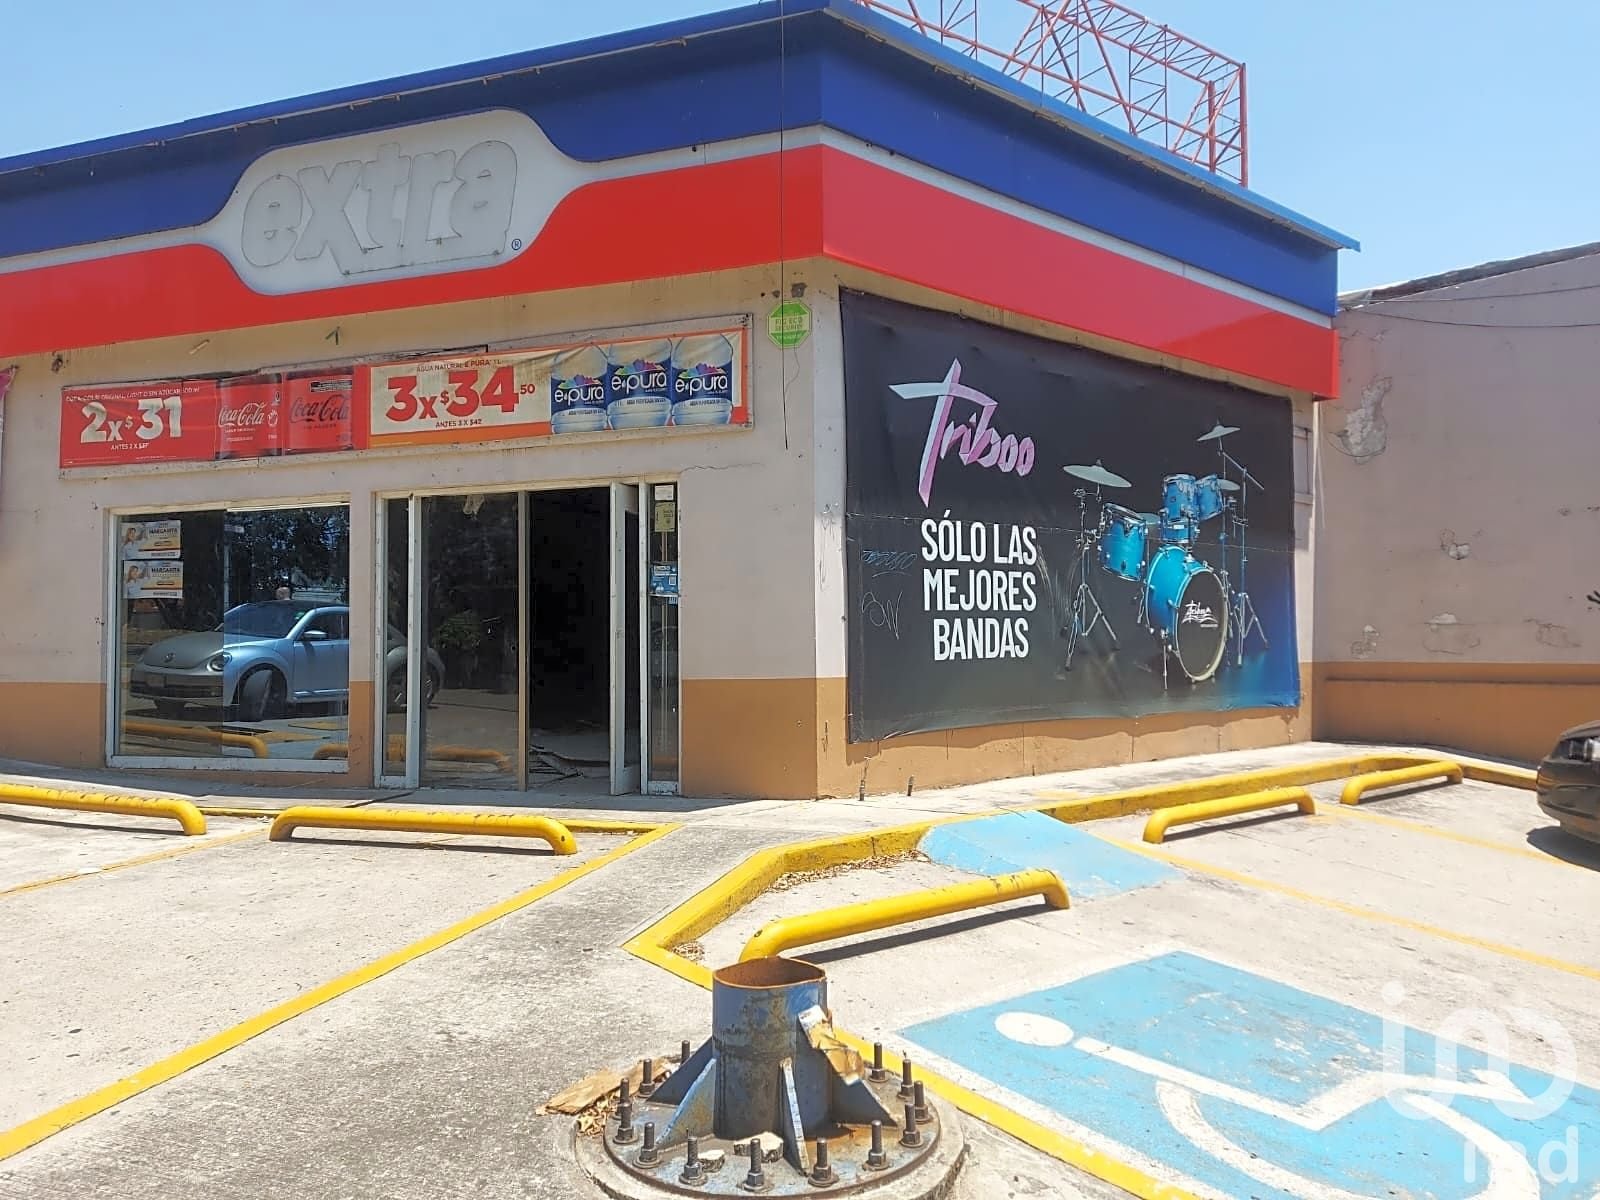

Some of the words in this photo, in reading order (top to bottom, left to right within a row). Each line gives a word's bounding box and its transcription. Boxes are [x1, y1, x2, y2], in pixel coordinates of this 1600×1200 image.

[241, 139, 518, 276] extra
[416, 364, 434, 373] AGUA
[435, 420, 456, 429] ANTES
[888, 357, 1036, 508] Triboo
[920, 510, 987, 563] SÓLO
[993, 522, 1037, 566] LAS
[923, 568, 1037, 612] MEJORES
[933, 617, 1029, 661] BANDAS
